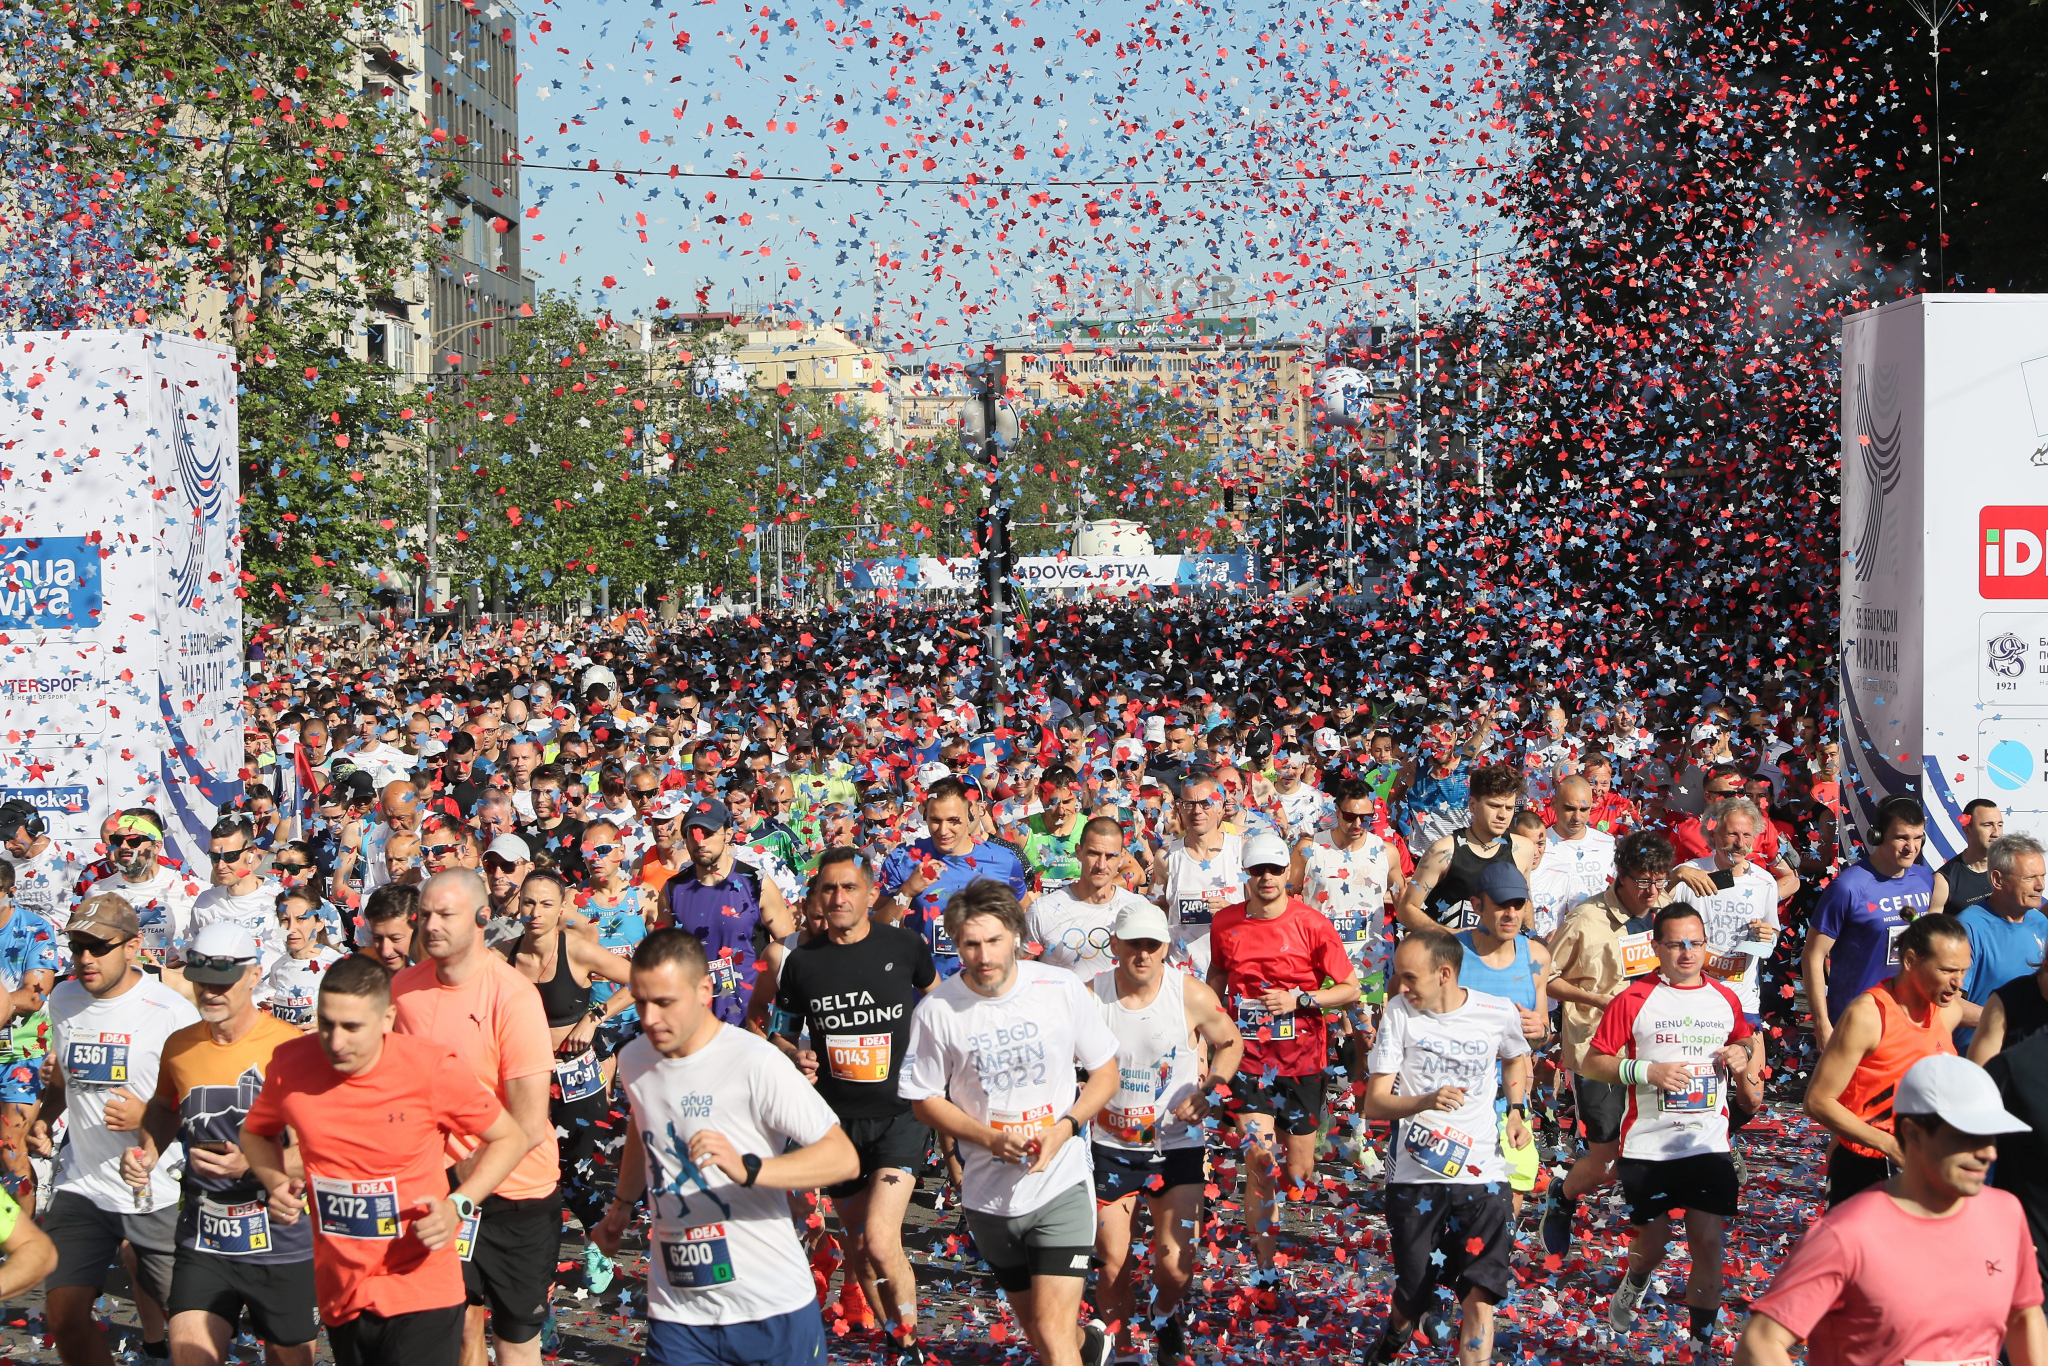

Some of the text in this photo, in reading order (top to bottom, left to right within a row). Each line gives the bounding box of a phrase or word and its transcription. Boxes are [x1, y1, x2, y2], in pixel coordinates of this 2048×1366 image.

[1986, 528, 2048, 577] iD
[1856, 638, 1898, 673] МАРАТОН
[1996, 682, 2017, 690] 1921
[1879, 891, 1930, 912] CETIN
[1709, 955, 1734, 971] 0181
[810, 991, 875, 1013] DELTA
[814, 1003, 903, 1031] HOLDING
[1655, 1020, 1725, 1029] BENU Apoteka
[1656, 1033, 1724, 1045] BELhospice
[74, 1045, 107, 1065] 5361
[835, 1049, 870, 1066] 0143
[976, 1041, 1045, 1074] MRTN
[1682, 1046, 1703, 1055] TIM
[115, 1069, 121, 1077] A
[880, 1067, 885, 1075] A
[1422, 1056, 1489, 1076] MRTN
[683, 1105, 711, 1117] viva
[1408, 1125, 1450, 1157] 3040
[327, 1195, 369, 1219] 2172
[203, 1214, 243, 1238] 3703
[384, 1222, 391, 1232] A
[254, 1236, 262, 1246] A
[458, 1243, 464, 1252] A
[670, 1243, 714, 1267] 6200
[719, 1267, 727, 1279] D
